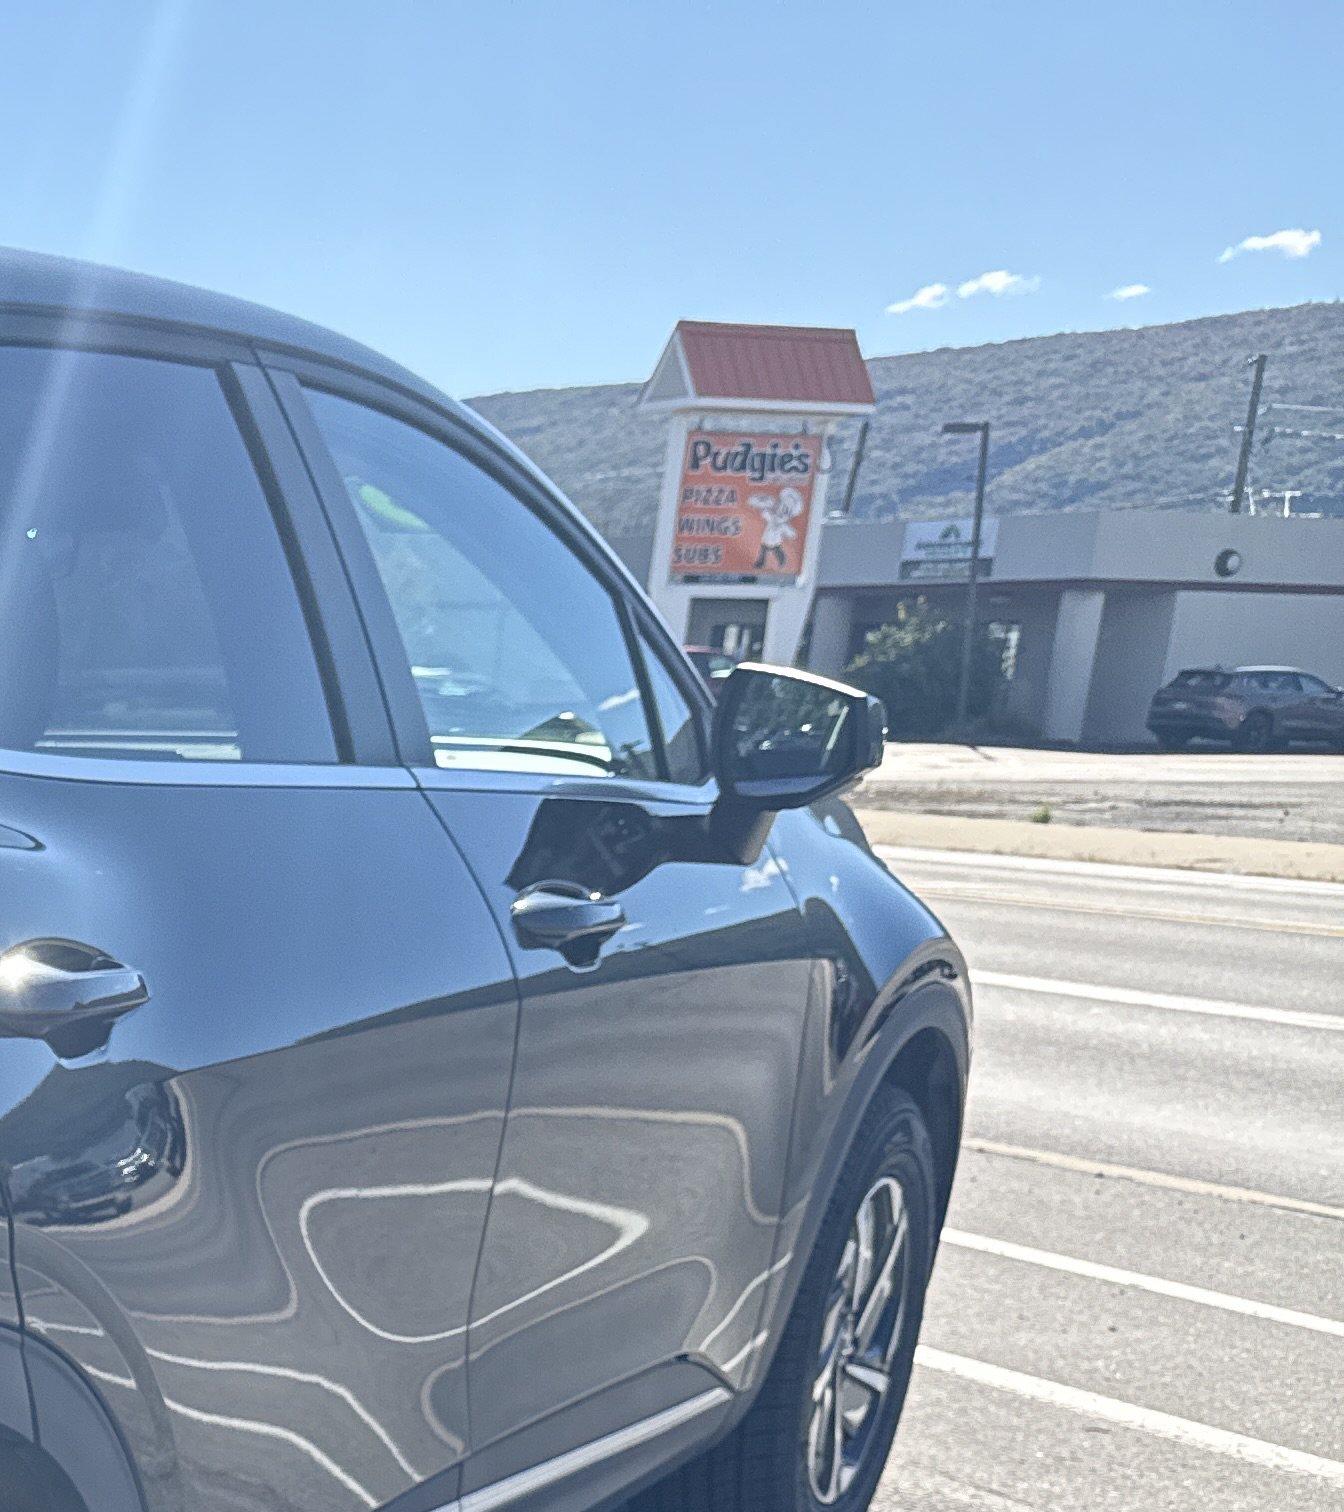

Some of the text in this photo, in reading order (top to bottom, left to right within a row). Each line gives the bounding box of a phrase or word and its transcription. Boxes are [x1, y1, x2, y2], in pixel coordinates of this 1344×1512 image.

[689, 440, 810, 481] Pudgie's
[681, 487, 737, 506] PIZZA
[678, 516, 743, 536] WINGS
[673, 545, 722, 564] SUBS
